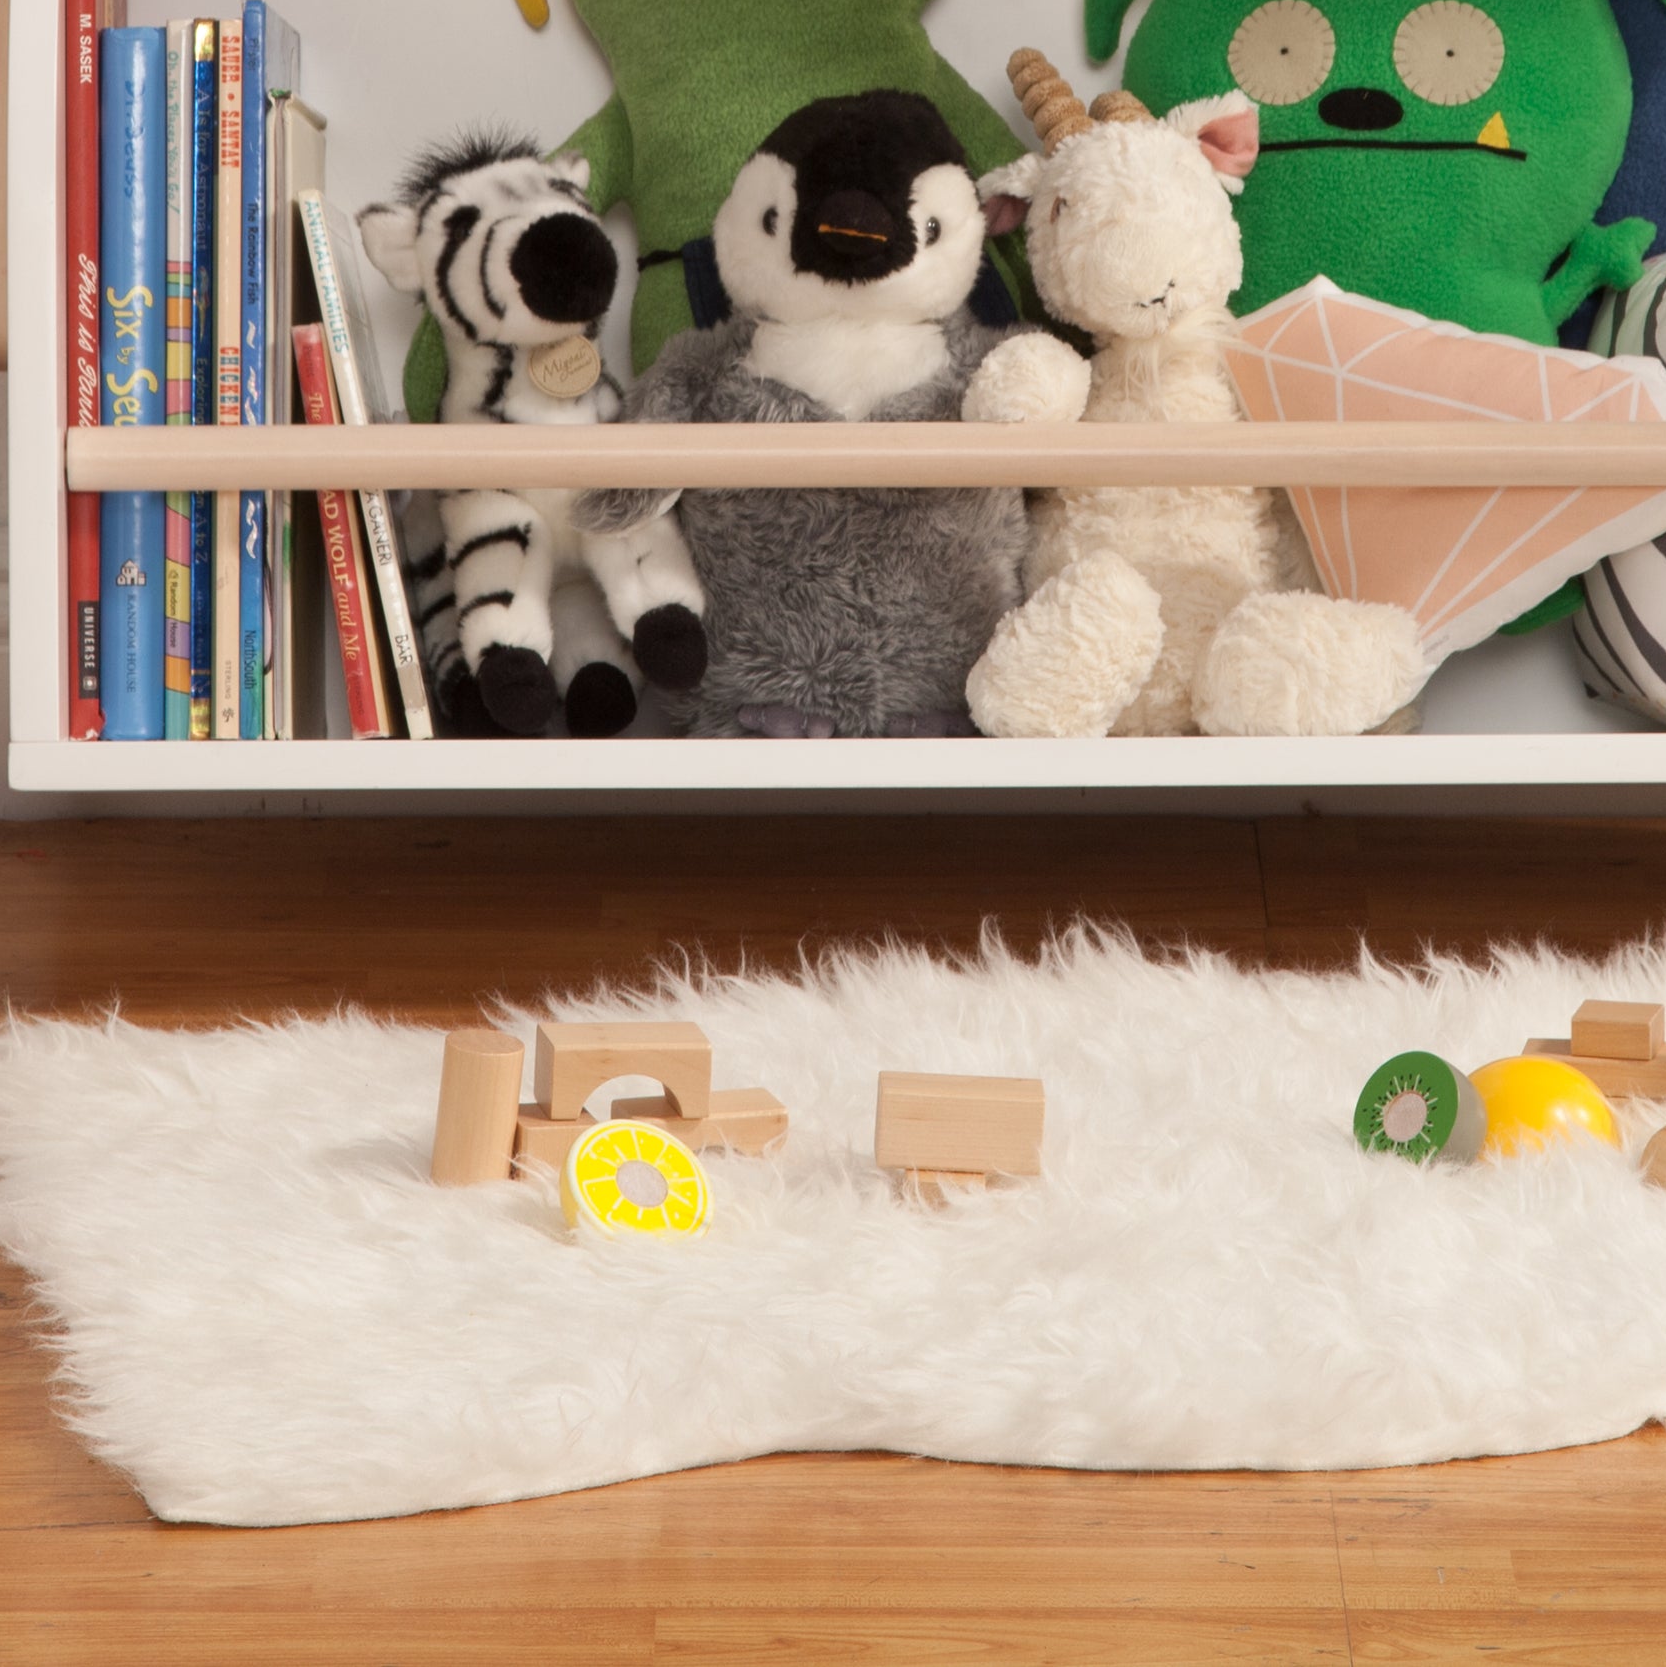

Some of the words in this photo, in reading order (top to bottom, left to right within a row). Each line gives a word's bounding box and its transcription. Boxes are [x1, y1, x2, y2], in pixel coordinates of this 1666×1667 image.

[79, 13, 92, 31] M.
[79, 36, 93, 84] SASEK
[221, 35, 241, 84] SAUER
[197, 88, 211, 104] A
[197, 109, 211, 126] Is
[197, 131, 211, 156] for
[221, 110, 241, 169] SANTAT
[196, 162, 211, 251] Astronaut
[247, 203, 259, 223] The
[247, 227, 259, 277] Rainbow
[78, 253, 97, 320] This
[247, 282, 259, 305] Fish
[305, 200, 329, 271] ANIMAL
[321, 274, 350, 355] FAMILIES
[106, 285, 154, 339] Six
[78, 322, 97, 353] is
[117, 346, 135, 365] by
[220, 346, 240, 416] CHICKEN
[309, 393, 324, 422] The
[195, 531, 209, 547] to
[327, 525, 352, 588] WOLF
[368, 510, 393, 567] GANERI
[169, 581, 179, 617] Random
[337, 591, 358, 628] and
[84, 606, 96, 669] UNIVERSE
[126, 594, 138, 649] RANDOM
[170, 622, 180, 648] House
[244, 628, 257, 690] NorthSouth
[342, 633, 361, 661] Me
[126, 652, 138, 693] HOUSE
